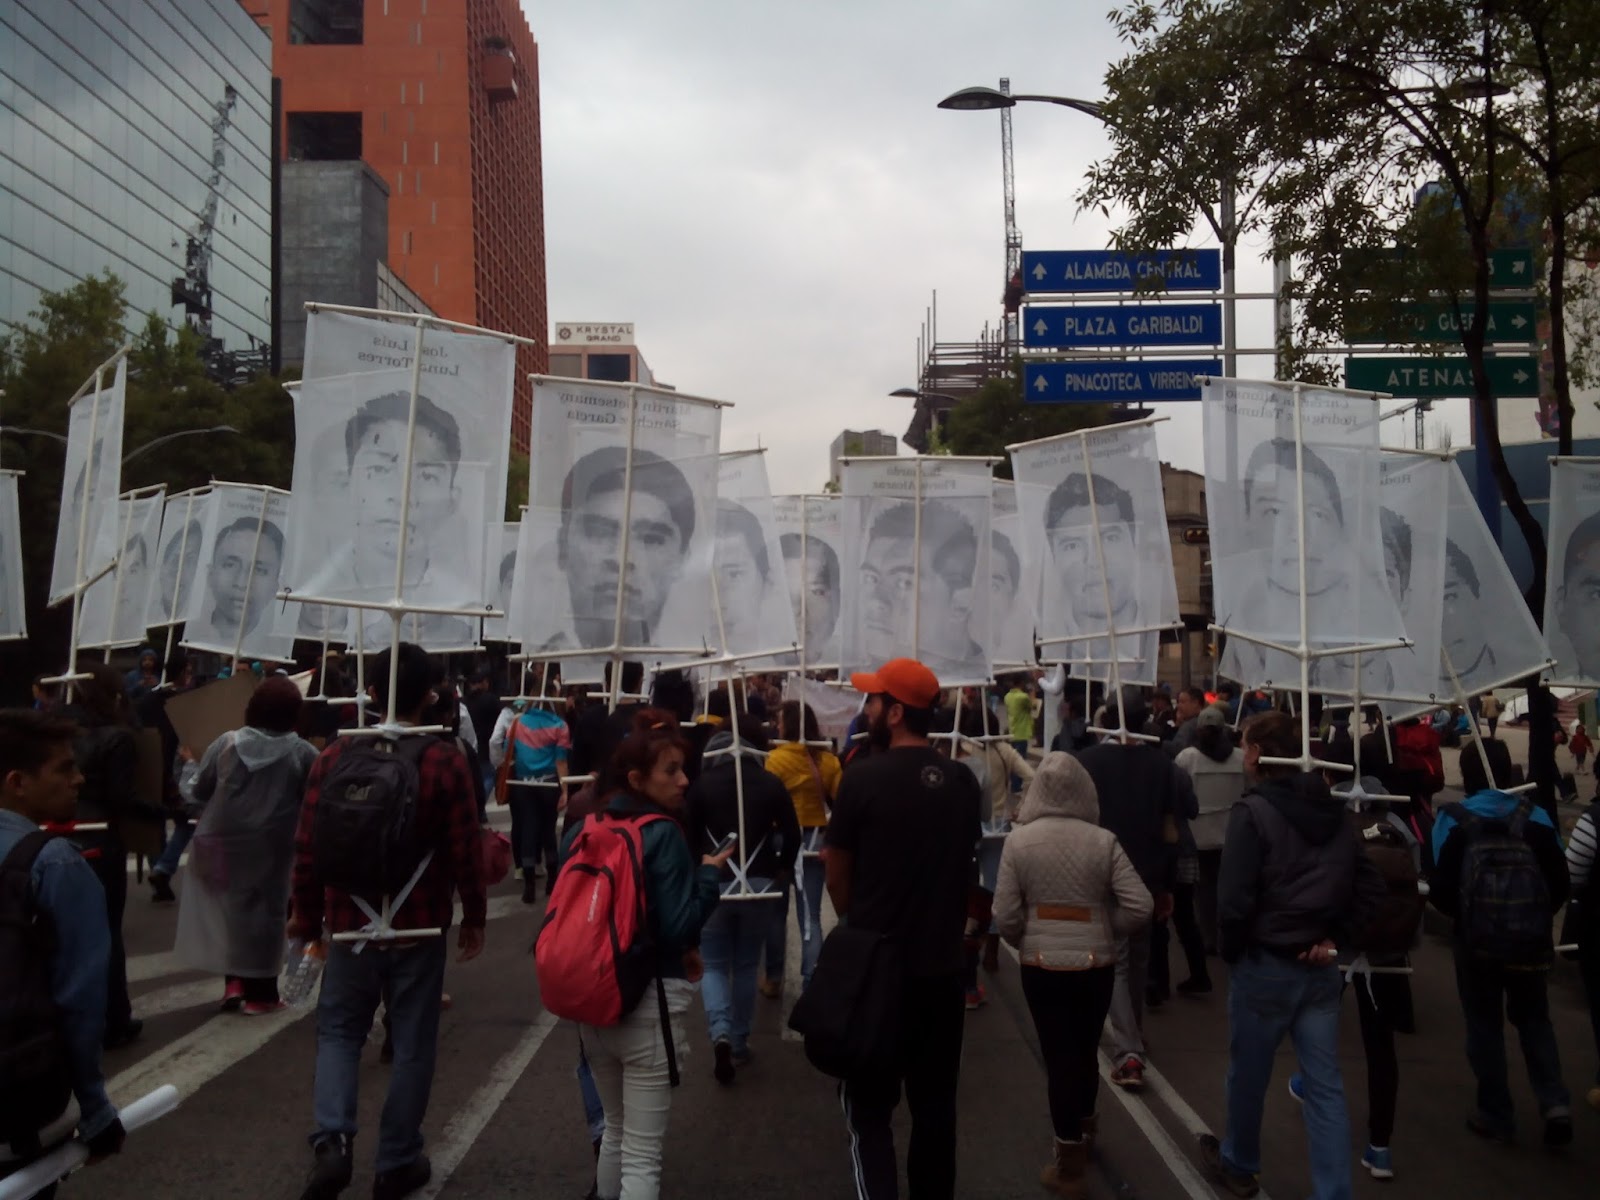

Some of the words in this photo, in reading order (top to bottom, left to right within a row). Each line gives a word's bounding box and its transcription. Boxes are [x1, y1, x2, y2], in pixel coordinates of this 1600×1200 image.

[1064, 261, 1131, 280] ALAMEDA
[576, 326, 632, 335] KRYSTAL
[1065, 317, 1117, 336] PLAZA
[1128, 315, 1203, 335] GARIBALDI
[1438, 313, 1496, 331] GUERA
[1065, 373, 1142, 392] PINACOTECA
[1149, 371, 1207, 391] VIRREIN
